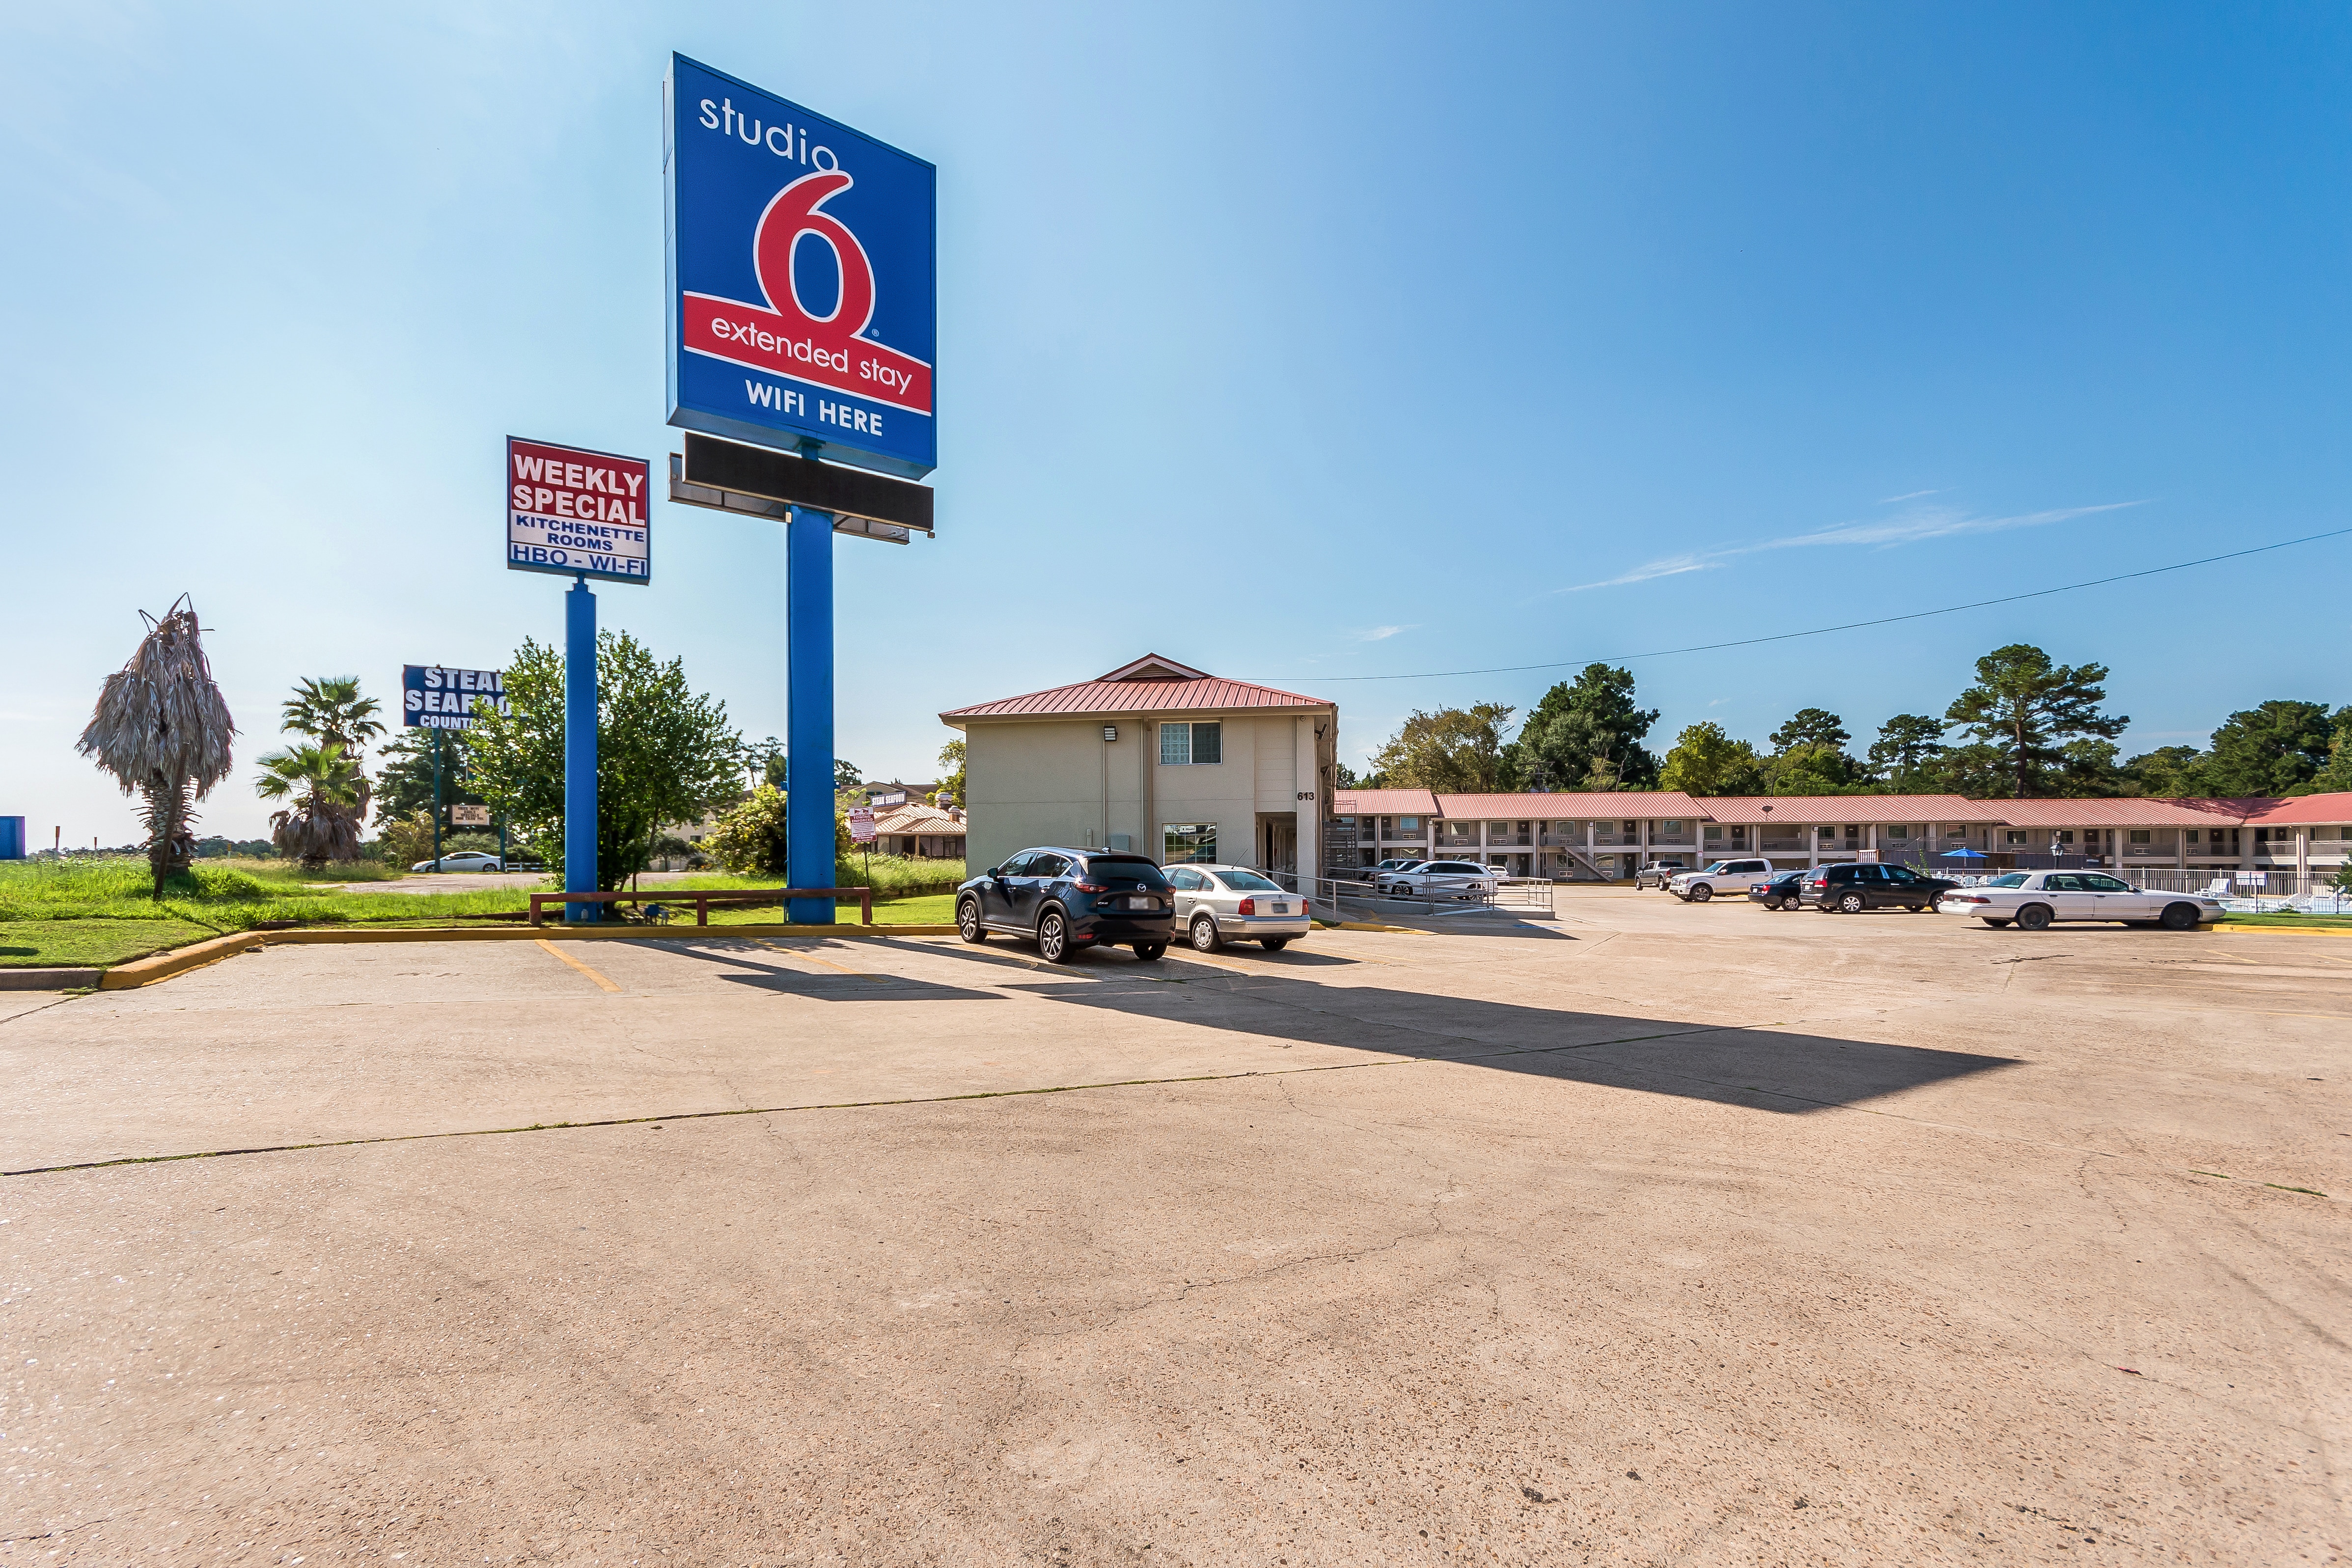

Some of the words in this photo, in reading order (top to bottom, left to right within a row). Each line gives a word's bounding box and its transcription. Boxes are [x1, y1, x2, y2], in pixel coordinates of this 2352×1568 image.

[699, 98, 838, 172] studio
[753, 169, 876, 337] 6
[711, 317, 849, 373] extended
[859, 358, 913, 395] stay
[745, 379, 805, 416] WIFI
[819, 399, 883, 436] HERE
[514, 454, 644, 497] WEEKLY
[513, 485, 645, 526] SPECIAL
[516, 515, 644, 542] KITCHENETTE
[547, 532, 613, 551] ROOMS
[513, 544, 568, 565] HBO
[588, 554, 645, 575] WI-FI
[405, 689, 529, 717] SEAFO
[420, 715, 486, 729] COUNT
[872, 796, 885, 806] STEAK
[885, 793, 905, 804] SEAFOOD
[1297, 792, 1315, 801] 613
